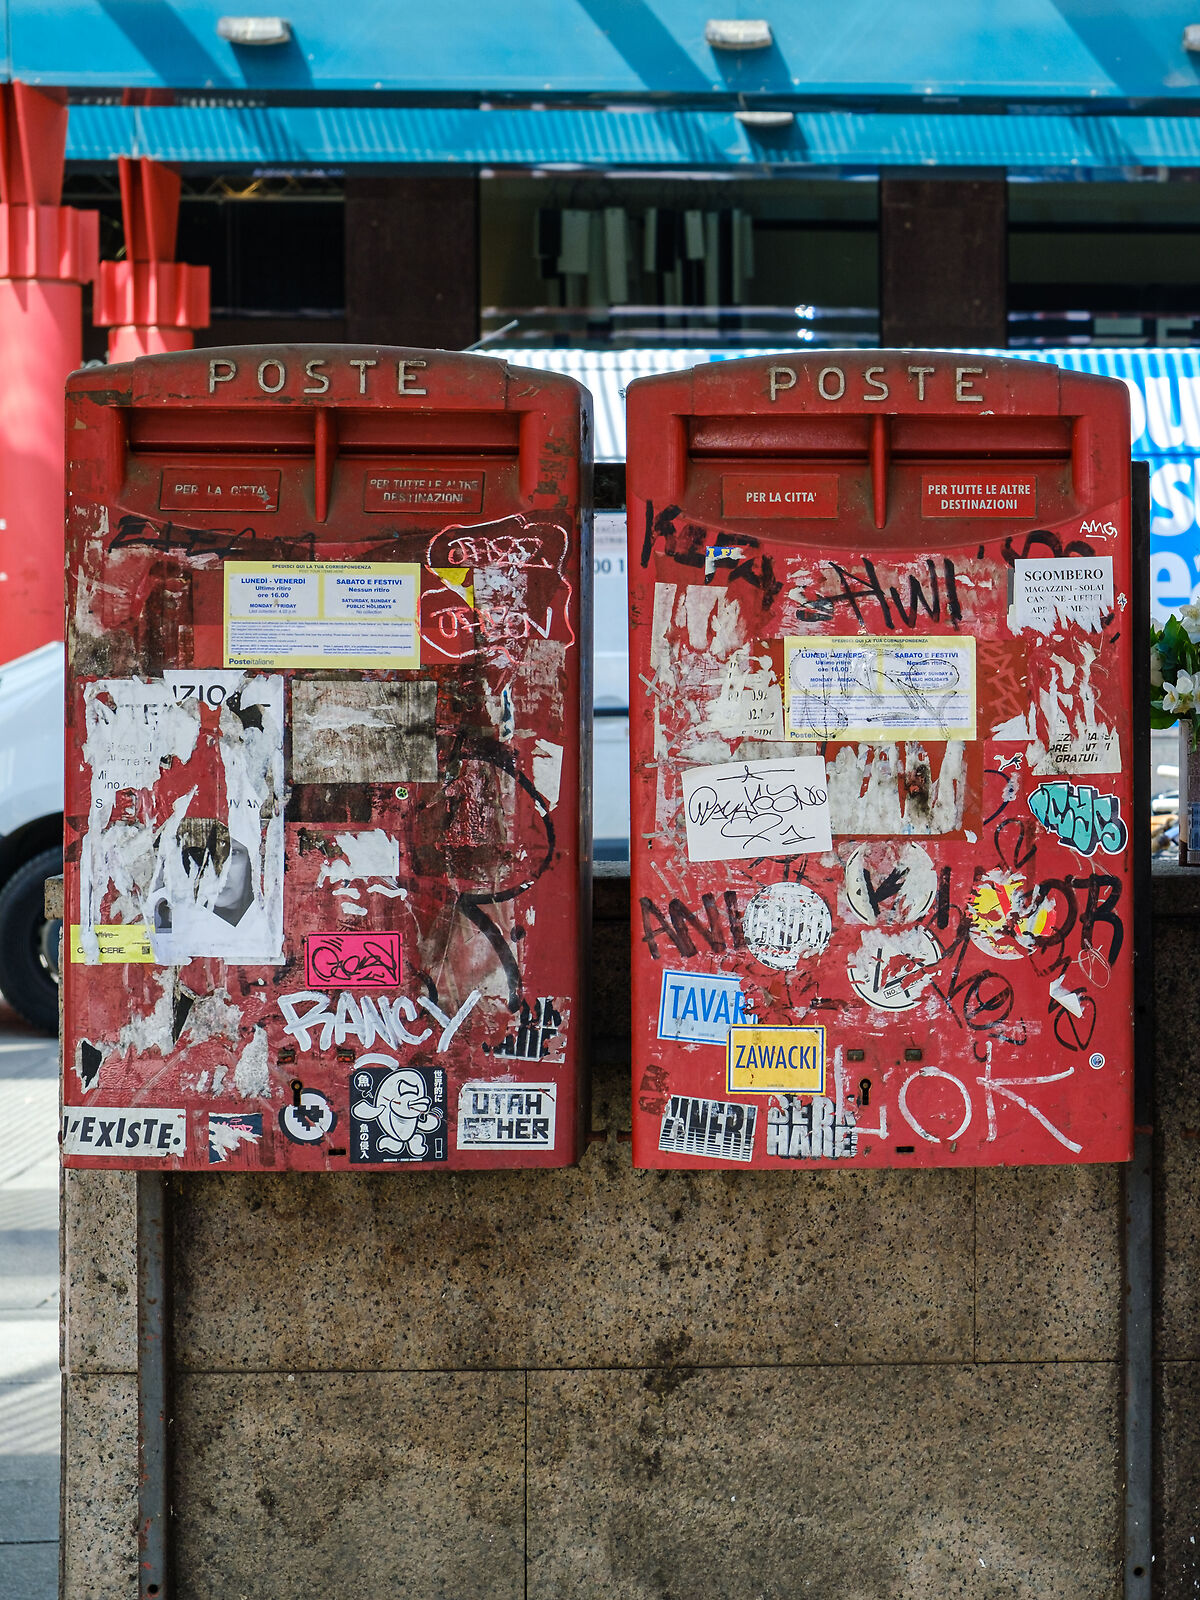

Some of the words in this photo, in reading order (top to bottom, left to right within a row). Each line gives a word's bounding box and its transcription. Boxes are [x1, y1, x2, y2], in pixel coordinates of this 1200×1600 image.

[208, 359, 428, 395] POSTE
[769, 366, 984, 402] POSTE
[175, 484, 198, 496] PER
[207, 484, 222, 496] LA
[928, 484, 948, 495] PER
[950, 484, 983, 495] TUTTE
[986, 484, 998, 495] LE
[1000, 484, 1031, 495] ALTRE
[746, 492, 768, 503] PER
[769, 492, 782, 503] LA
[784, 492, 817, 503] CITTA'
[941, 499, 1018, 510] DESTINAZIONI
[1024, 568, 1104, 582] SGOMBERO
[1024, 585, 1073, 593] MAGAZZINI
[228, 658, 274, 666] Posteitaliane
[277, 989, 482, 1053] RANCY
[735, 1045, 817, 1070] ZAWACKI
[357, 1074, 370, 1088] 魚
[433, 1069, 443, 1103] 世界的に
[472, 1093, 542, 1115] UTAH
